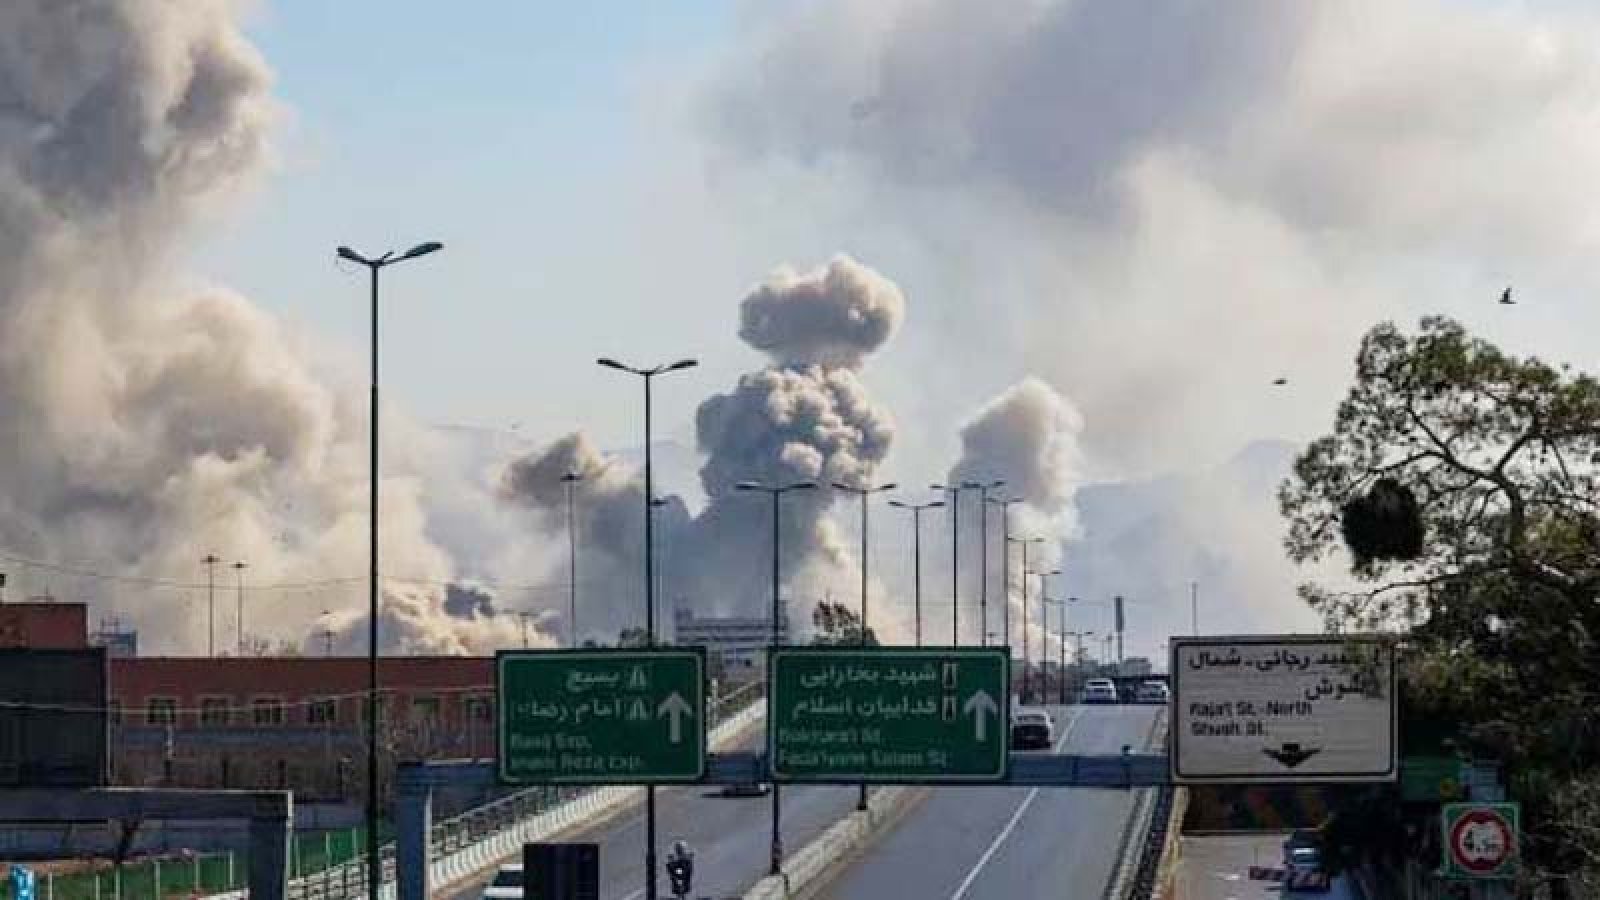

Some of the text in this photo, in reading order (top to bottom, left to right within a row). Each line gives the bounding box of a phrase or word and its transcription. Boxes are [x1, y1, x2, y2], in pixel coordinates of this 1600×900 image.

[1189, 648, 1241, 670] شمال
[566, 668, 621, 693] بسیج
[884, 663, 936, 688] شهید
[575, 697, 621, 724] امام
[791, 695, 851, 721] اسلام
